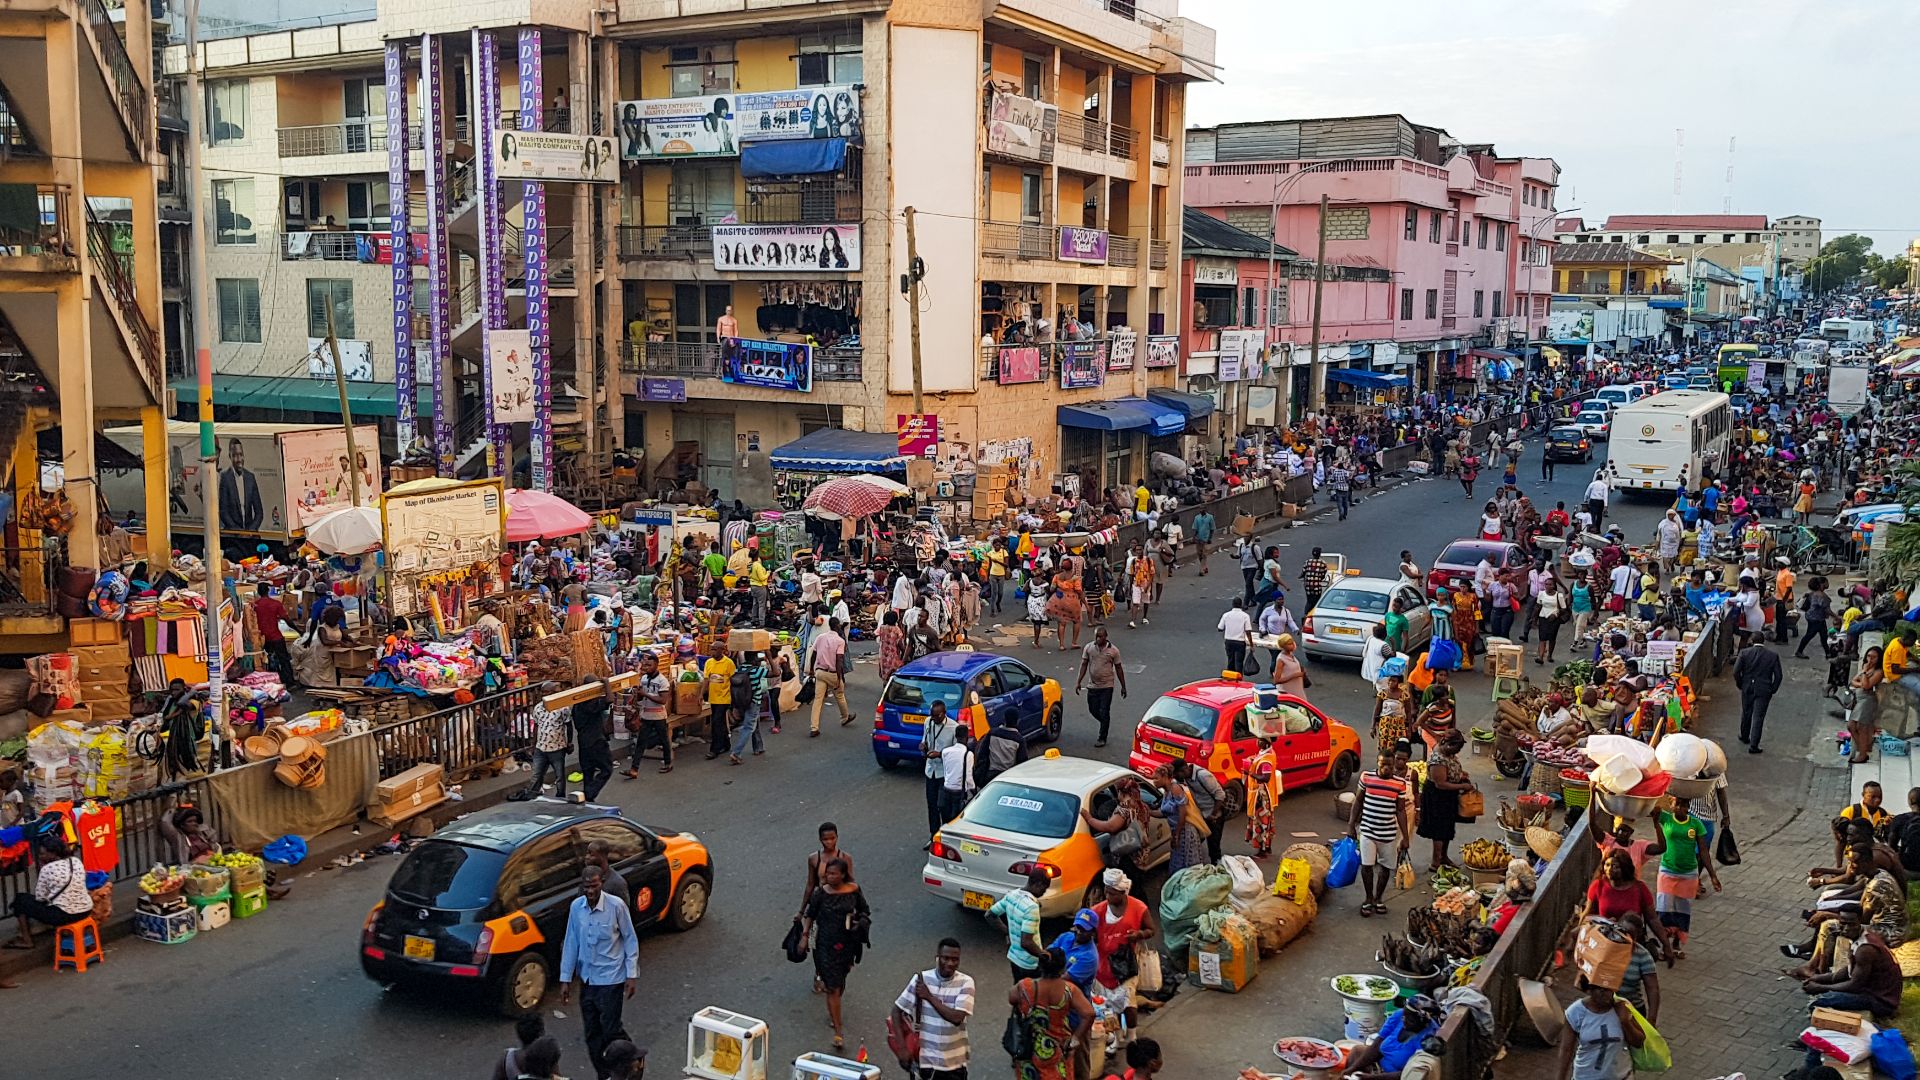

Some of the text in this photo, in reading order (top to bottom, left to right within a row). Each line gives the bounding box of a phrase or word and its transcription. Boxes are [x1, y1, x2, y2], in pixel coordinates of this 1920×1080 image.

[545, 137, 580, 145] ENTERPRISE
[542, 143, 572, 151] COMPANY
[749, 227, 787, 236] COMPANY
[790, 226, 823, 235] LIMTED
[404, 499, 418, 508] Map
[456, 491, 477, 500] Market
[88, 823, 110, 840] USA
